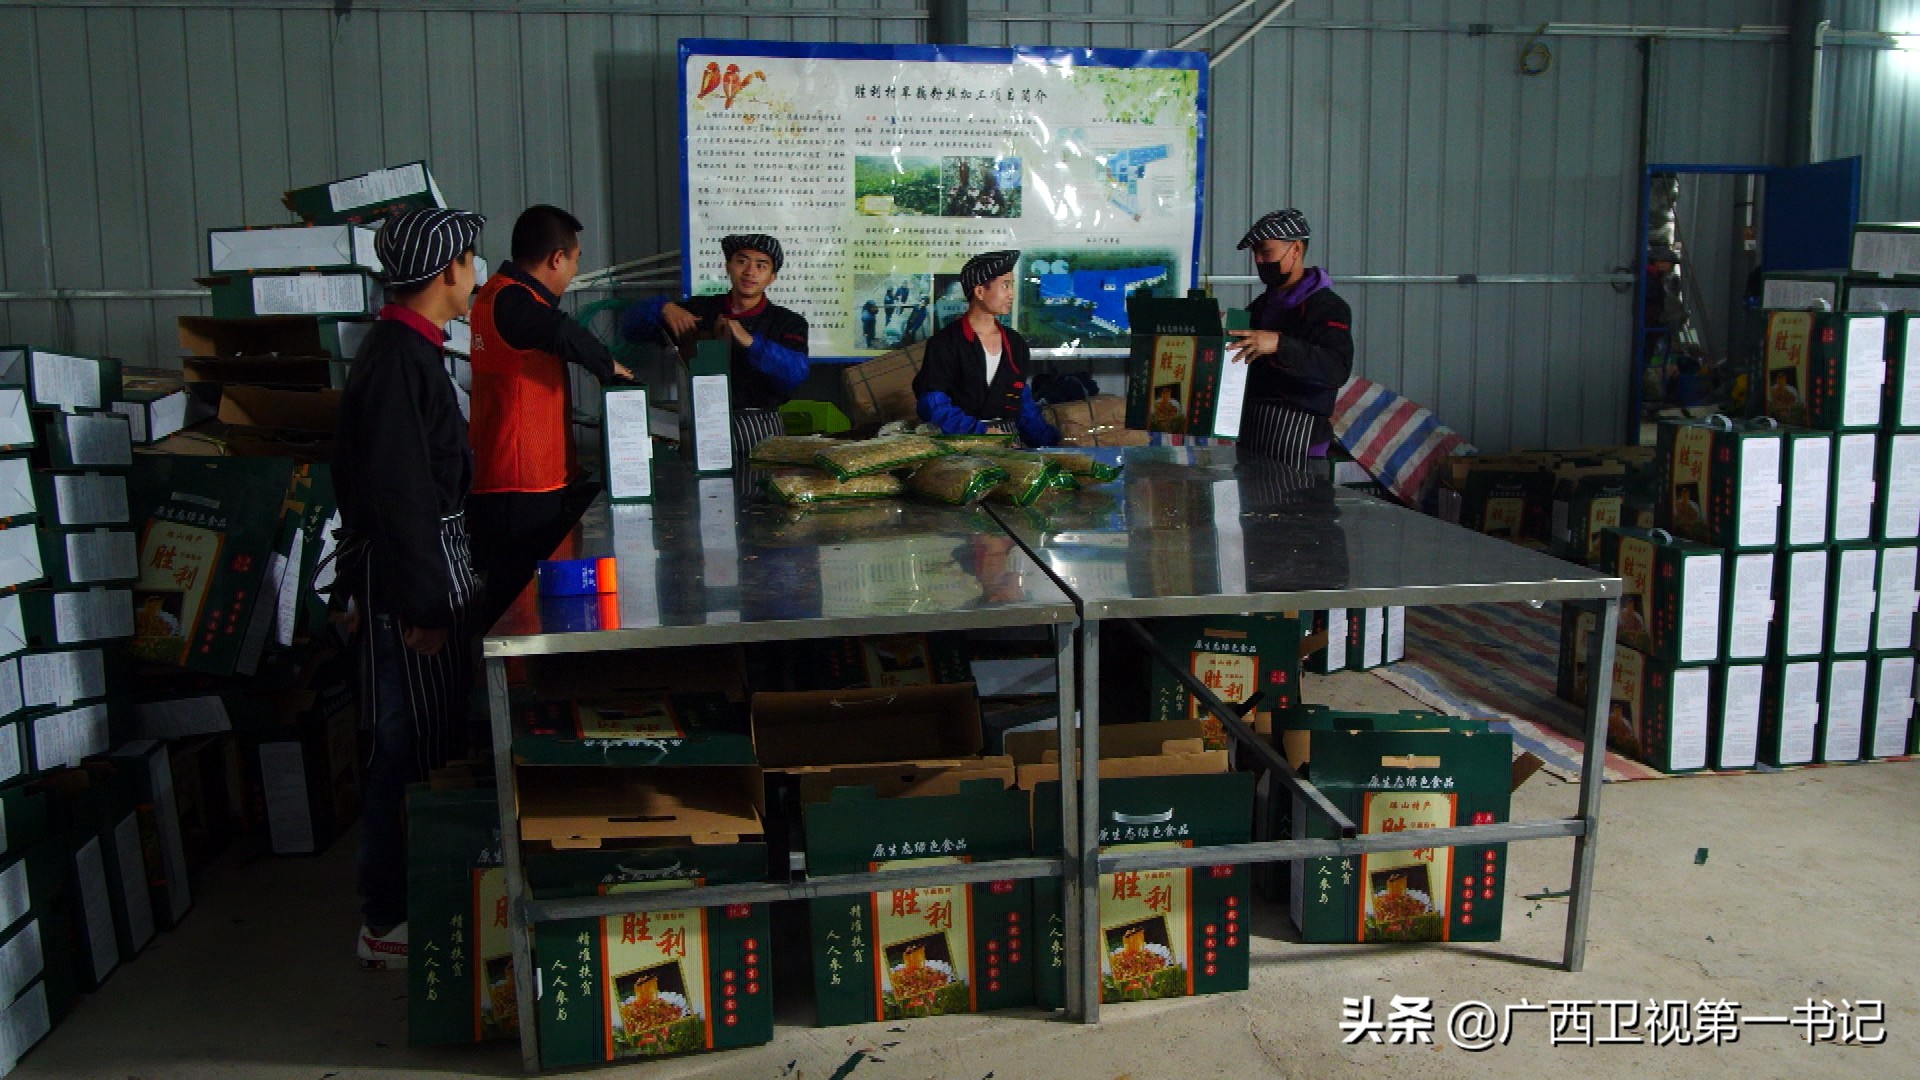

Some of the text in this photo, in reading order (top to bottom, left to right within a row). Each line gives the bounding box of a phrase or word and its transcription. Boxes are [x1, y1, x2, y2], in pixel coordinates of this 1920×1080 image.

[150, 545, 200, 591] 胜利
[1204, 669, 1243, 702] 胜利
[1367, 775, 1455, 789] 原生态绿色食品
[873, 837, 967, 857] 原生态绿色食品
[1099, 823, 1190, 842] 原生态绿色食品
[891, 887, 952, 929] 胜利
[1112, 872, 1172, 912] 胜利
[621, 912, 686, 958] 胜利
[849, 904, 865, 963] 精准扶贫
[577, 932, 593, 997] 精准扶贫
